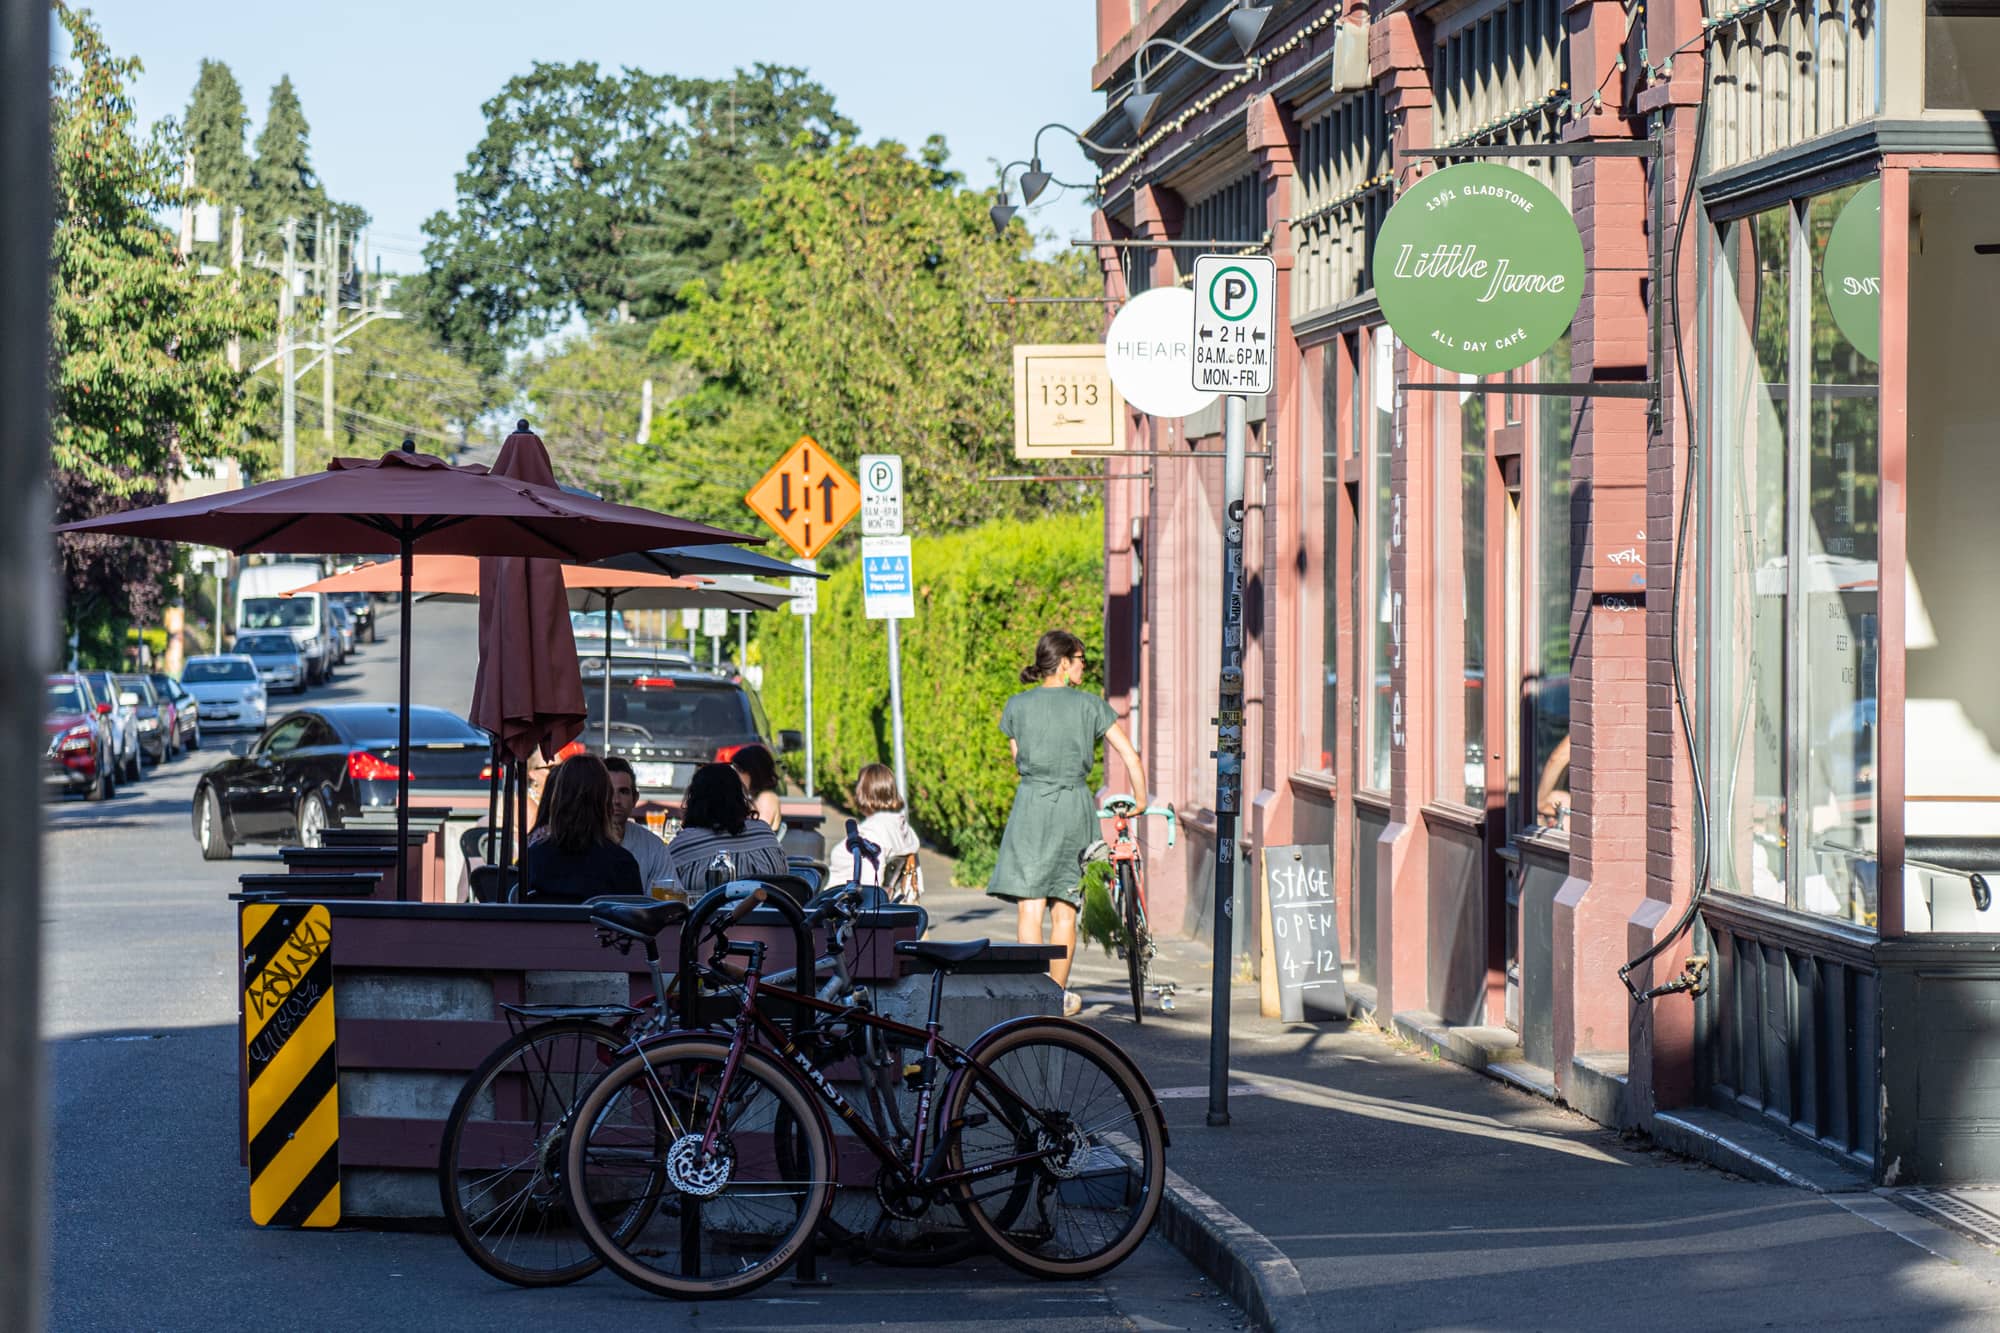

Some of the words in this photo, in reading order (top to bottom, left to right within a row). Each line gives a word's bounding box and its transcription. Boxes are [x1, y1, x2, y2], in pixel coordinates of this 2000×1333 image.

[1463, 185, 1535, 214] GLADSTONE
[1394, 244, 1489, 279] Little
[1476, 259, 1566, 303] June
[1224, 278, 1247, 311] P
[1220, 327, 1229, 343] 2
[1235, 327, 1246, 344] H
[1431, 329, 1455, 348] ALL
[1463, 340, 1488, 352] DAY
[1495, 327, 1528, 350] CAFÉ
[1040, 384, 1099, 406] 1313
[876, 467, 887, 486] P
[1276, 912, 1332, 943] OPEN
[794, 1051, 845, 1107] MASI
